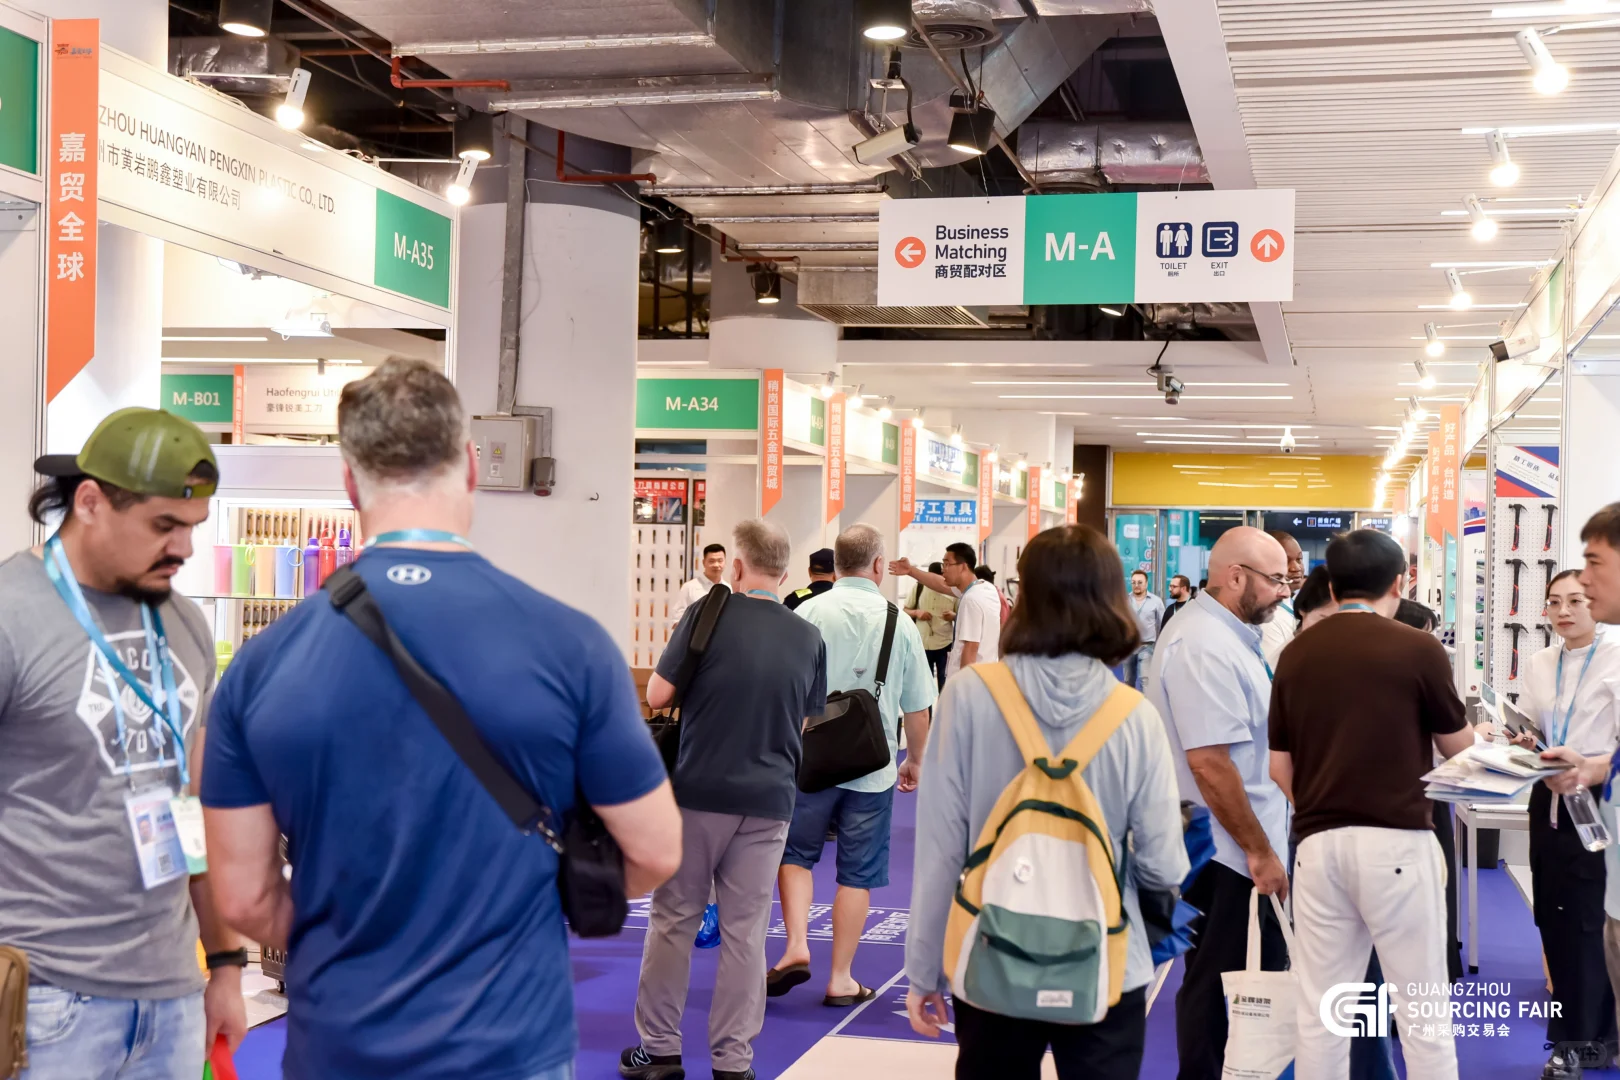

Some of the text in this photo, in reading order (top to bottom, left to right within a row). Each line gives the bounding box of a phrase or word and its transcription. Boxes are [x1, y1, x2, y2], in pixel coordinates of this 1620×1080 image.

[140, 123, 206, 164] HUANGYAN
[209, 149, 256, 184] PENGXIN
[259, 169, 297, 200] PLASTIC
[299, 186, 317, 209] CO.,
[318, 193, 336, 215] LTD.
[57, 132, 86, 282] 嘉贸全球
[935, 224, 1009, 240] Business
[394, 231, 434, 270] M-A35
[935, 243, 1007, 262] Matching
[1044, 231, 1116, 262] M-A
[935, 263, 1007, 279] 商贸配对区
[1160, 262, 1187, 270] TOILET
[1210, 261, 1228, 269] EXIT
[173, 391, 220, 406] M-B01
[266, 387, 320, 399] Haofengrui
[665, 396, 719, 411] M-A34
[925, 515, 942, 524] Tape
[944, 515, 973, 523] Measure
